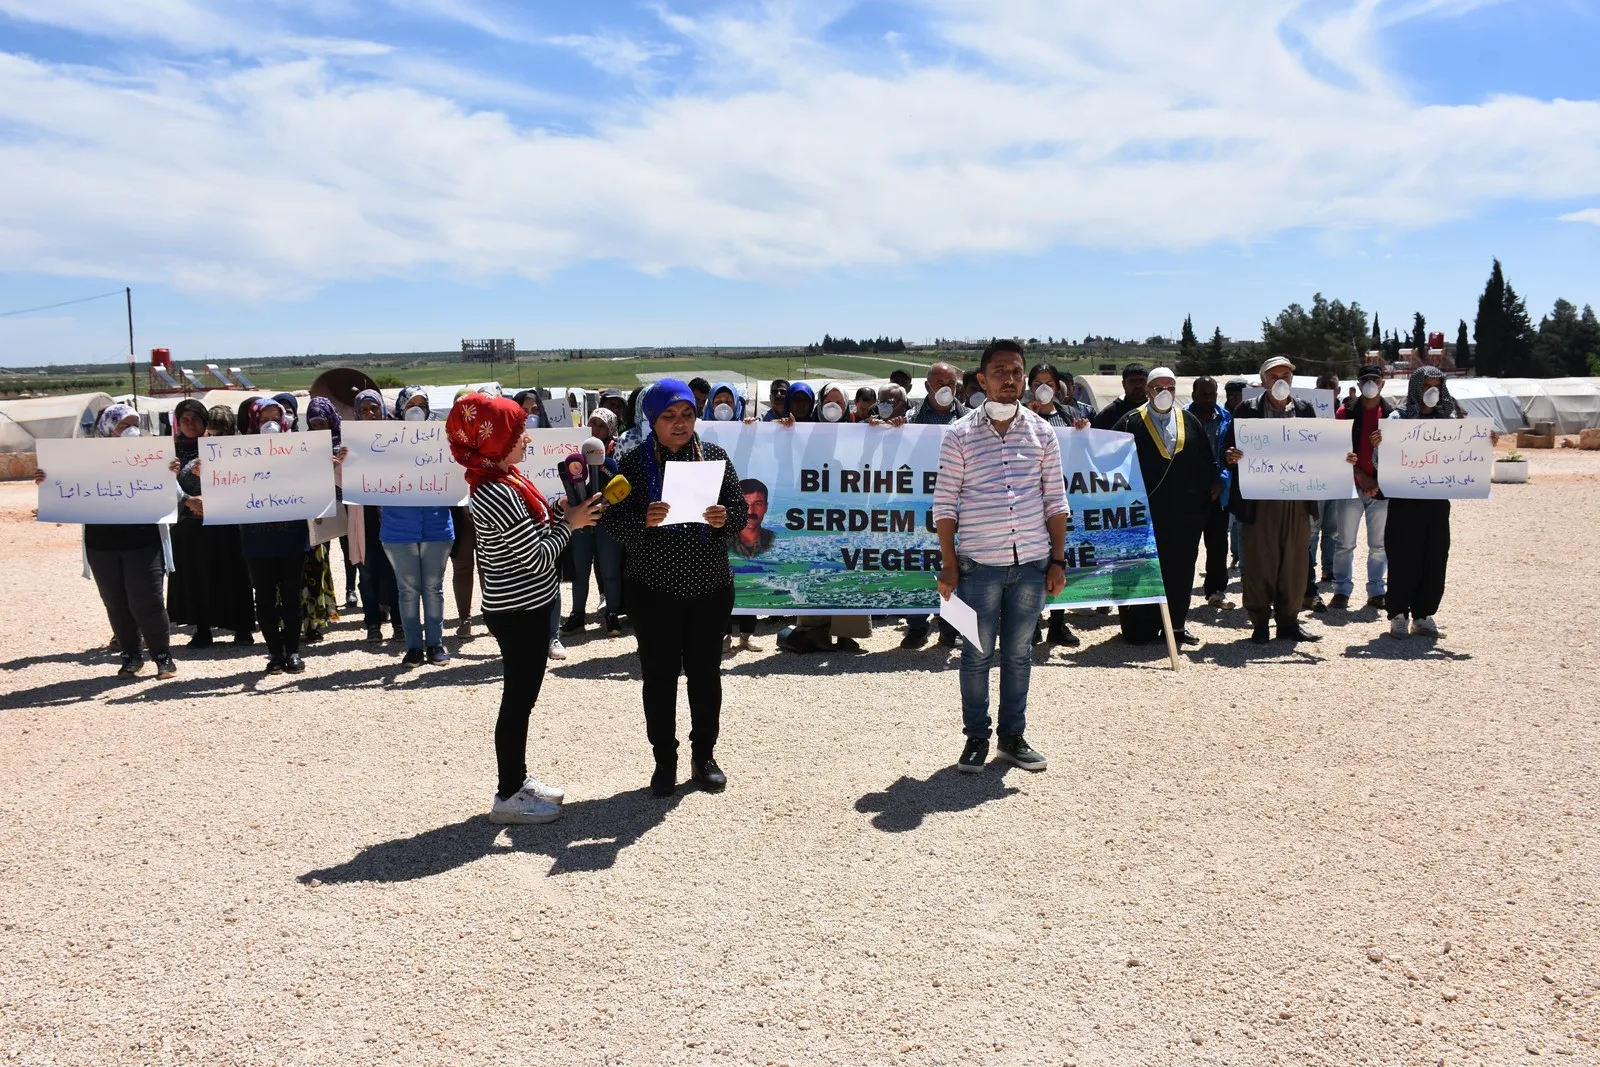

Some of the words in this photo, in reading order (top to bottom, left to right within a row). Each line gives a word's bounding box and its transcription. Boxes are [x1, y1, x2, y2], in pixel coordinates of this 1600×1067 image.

[232, 446, 262, 458] axa
[269, 438, 294, 457] bav
[784, 507, 915, 533] SERDEM
[1083, 499, 1148, 531] EMÊ
[840, 547, 943, 572] VEGER
